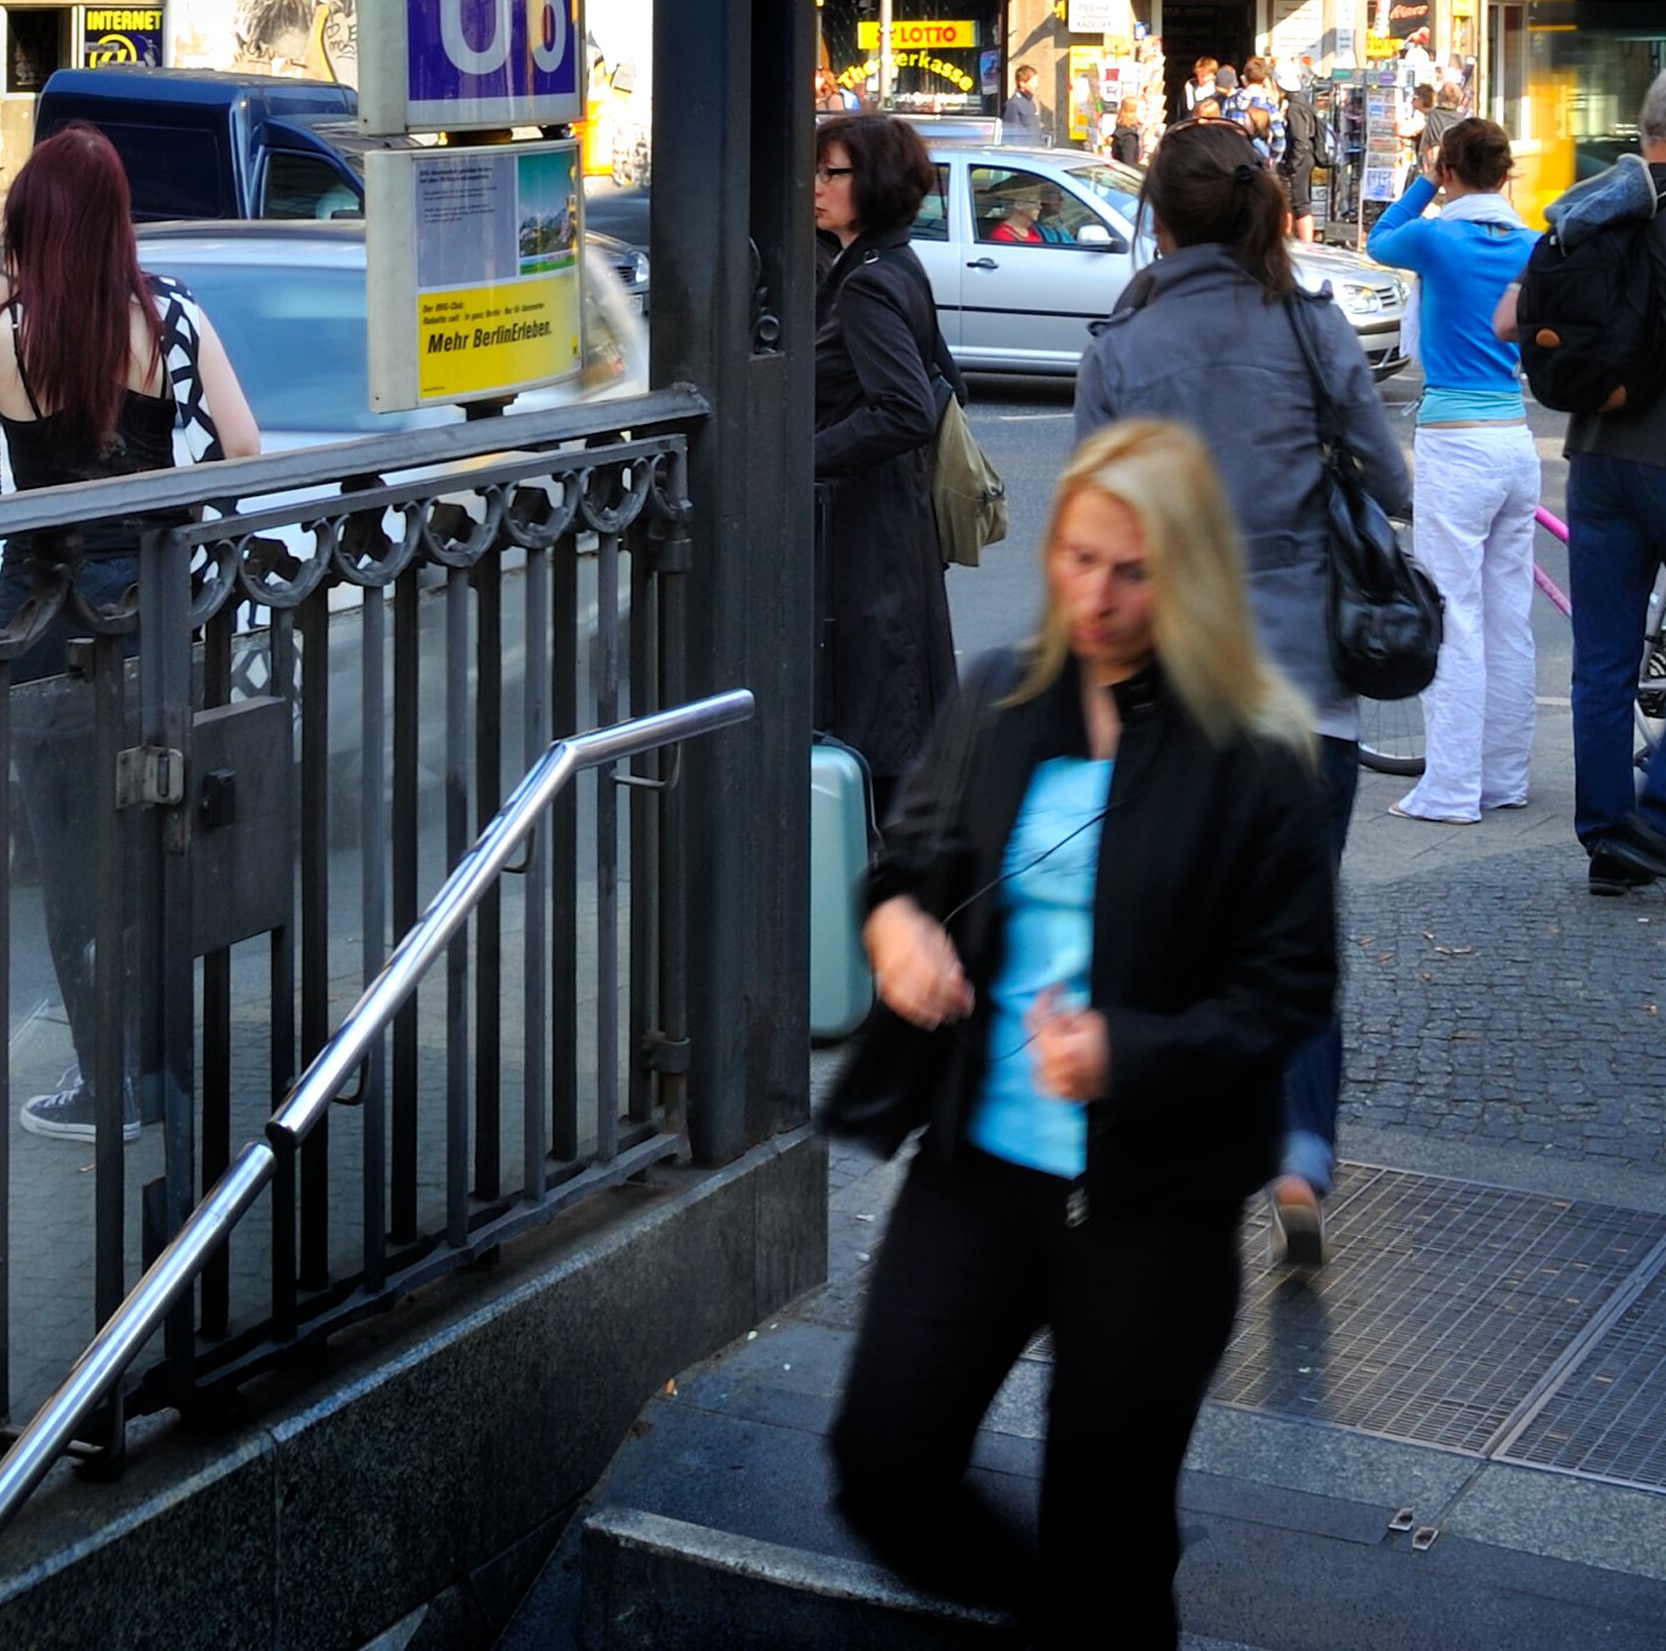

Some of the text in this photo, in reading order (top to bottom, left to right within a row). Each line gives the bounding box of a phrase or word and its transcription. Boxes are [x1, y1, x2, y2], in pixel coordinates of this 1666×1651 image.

[87, 11, 162, 30] INTERNET
[901, 27, 957, 43] LOTTO
[427, 320, 552, 354] Mehr BerlinErleben.
